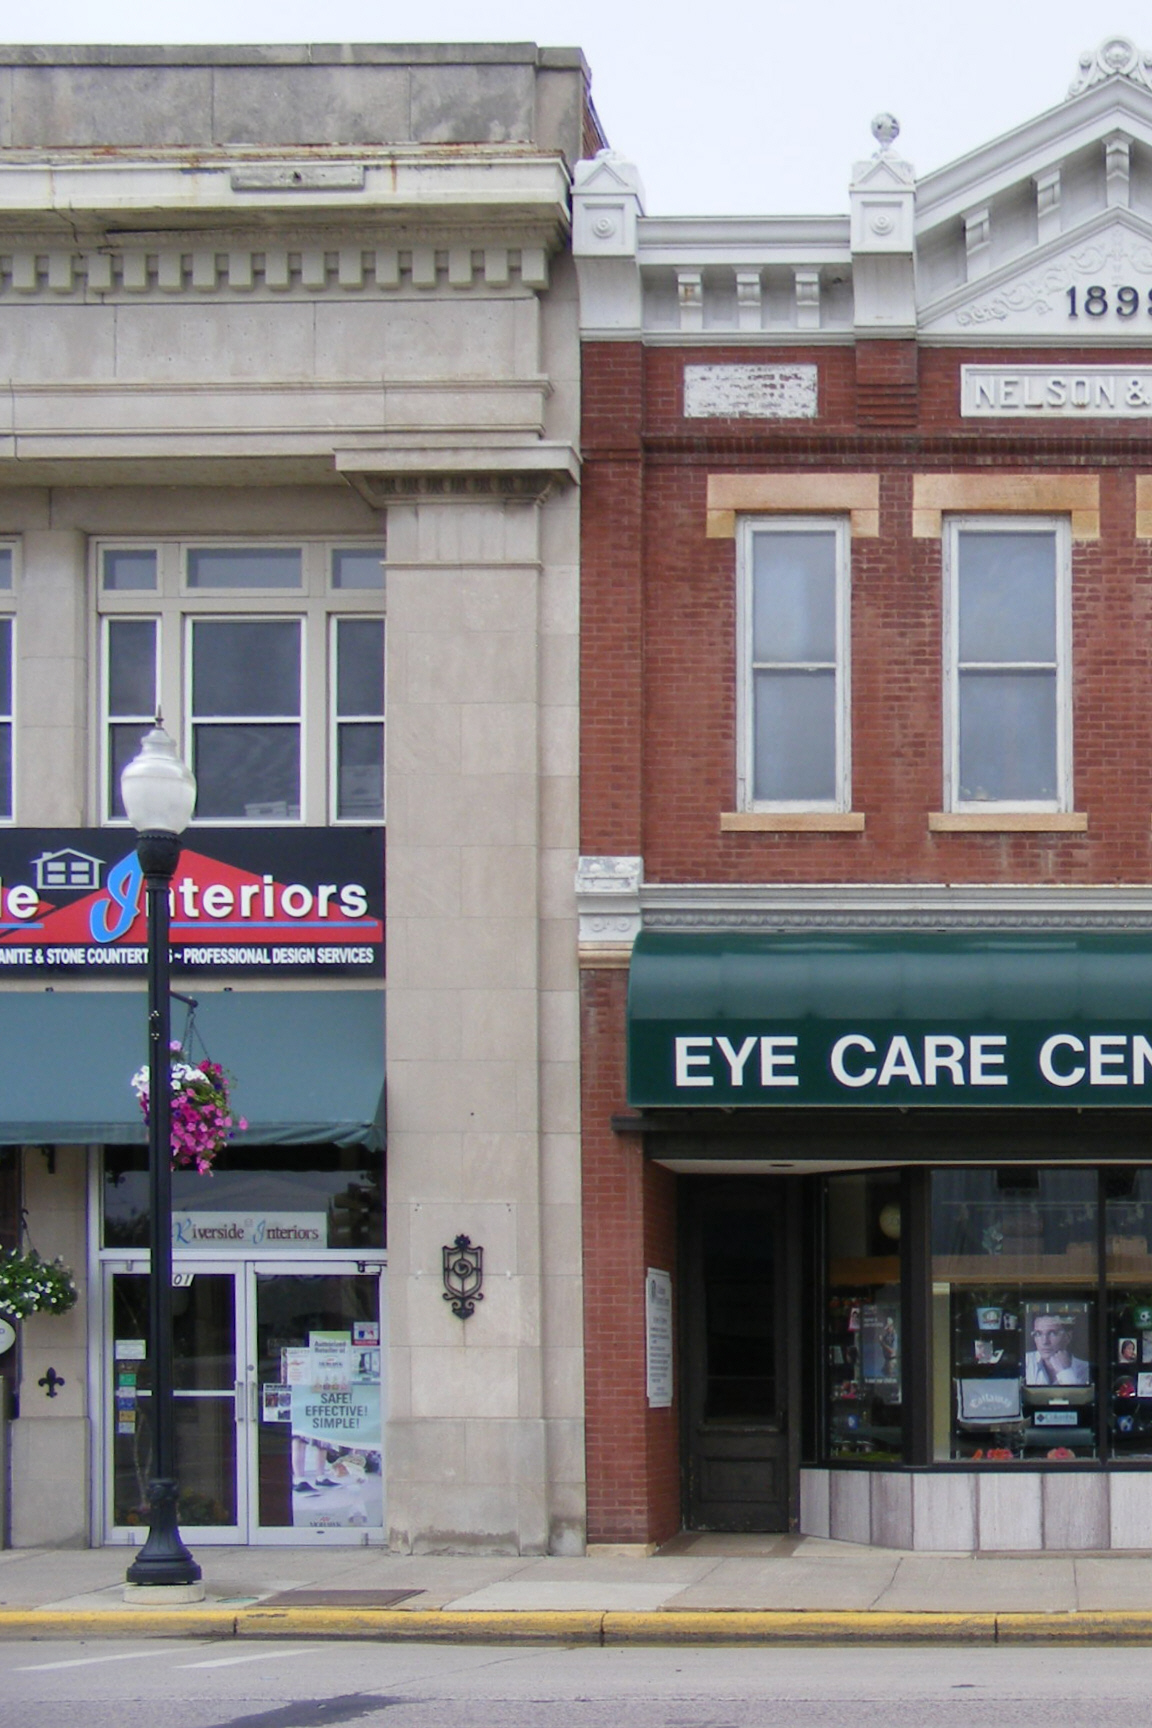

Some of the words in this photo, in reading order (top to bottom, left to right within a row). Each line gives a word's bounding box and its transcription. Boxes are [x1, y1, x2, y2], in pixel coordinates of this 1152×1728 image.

[975, 376, 1115, 409] NELSON
[1125, 376, 1151, 406] &
[0, 876, 39, 919] e
[90, 848, 368, 943] Iteriors
[35, 948, 44, 965] &
[47, 948, 86, 965] STONE
[87, 948, 173, 965] COUNTERT
[183, 947, 271, 964] PROFESSIONAL
[272, 947, 315, 964] DESIGN
[317, 947, 374, 964] SERVICES
[675, 1036, 799, 1086] EYE
[831, 1034, 1008, 1087] CARE
[174, 1218, 245, 1244] Riverside
[252, 1219, 319, 1245] Interiors
[321, 1393, 353, 1404] SAFE!
[305, 1405, 368, 1416] EFFECTIVE!
[313, 1418, 360, 1429] SIMPLE!
